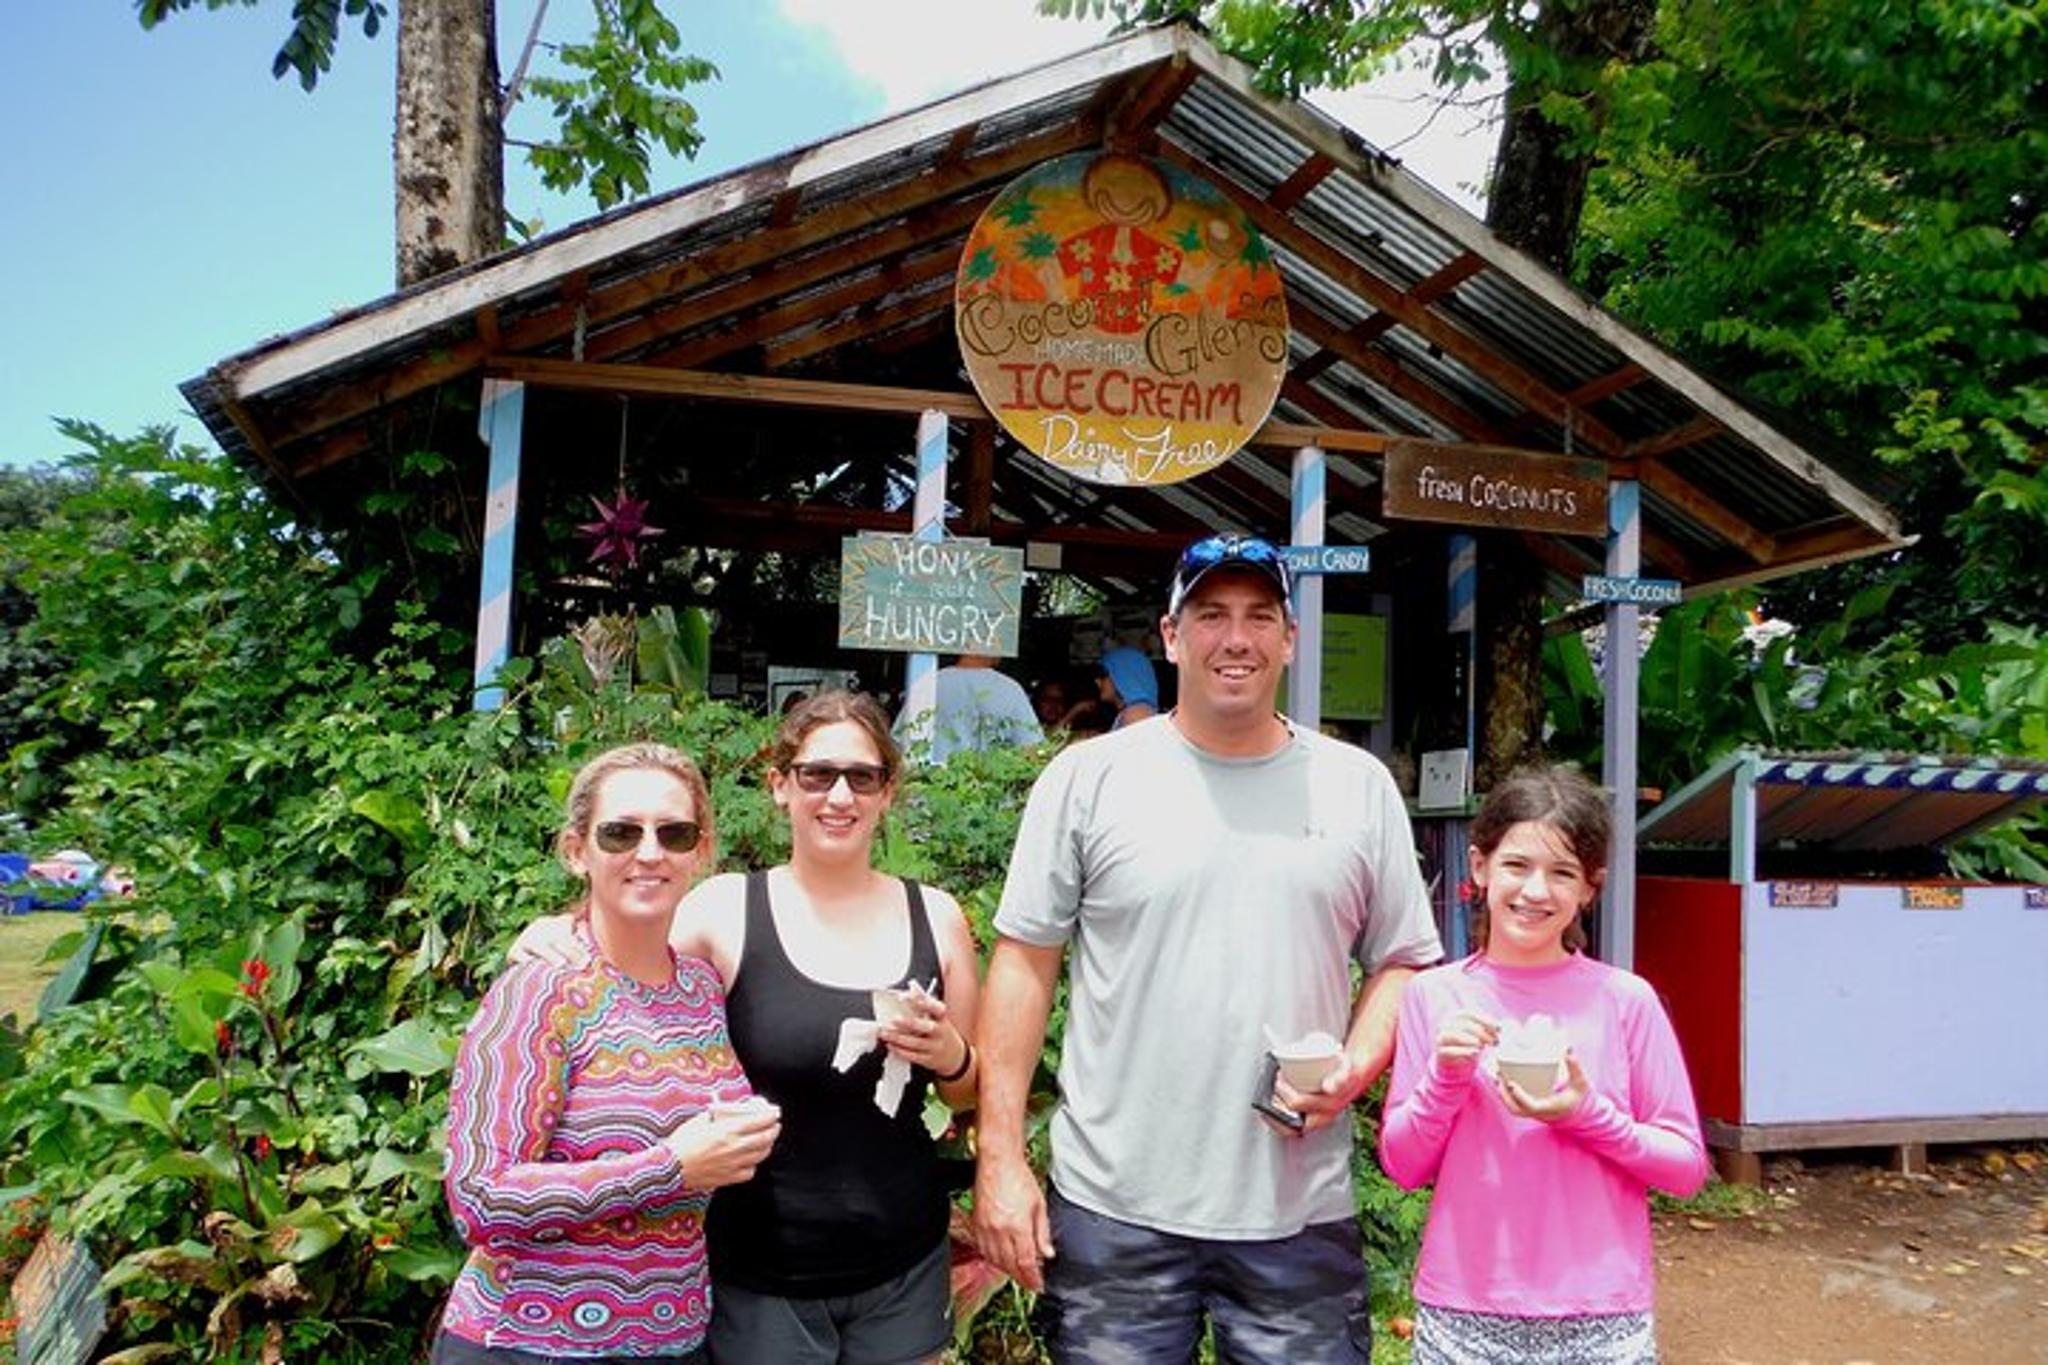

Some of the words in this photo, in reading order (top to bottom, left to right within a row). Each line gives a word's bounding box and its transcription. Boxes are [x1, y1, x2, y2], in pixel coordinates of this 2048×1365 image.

[1039, 414, 1132, 476] Dairy
[1122, 425, 1233, 481] Free
[864, 595, 1004, 648] HUNGRY
